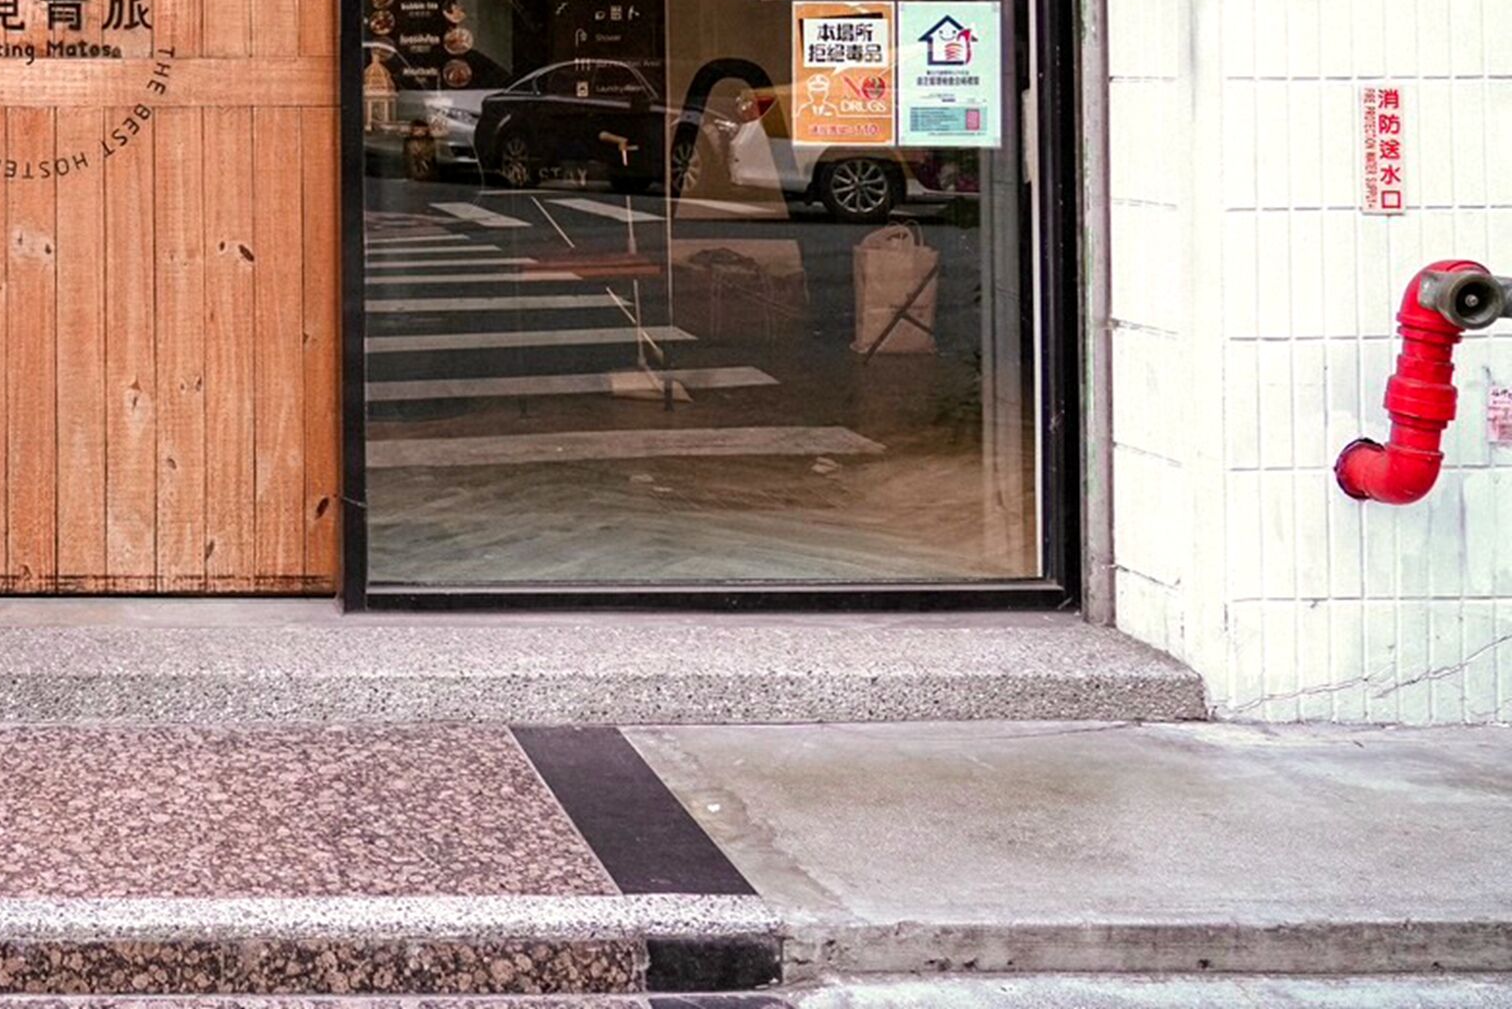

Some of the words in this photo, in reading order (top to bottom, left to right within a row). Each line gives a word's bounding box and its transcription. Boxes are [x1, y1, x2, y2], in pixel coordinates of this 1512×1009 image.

[816, 22, 874, 42] 本場所
[45, 40, 112, 59] Mates
[808, 43, 883, 63] 拒絕毒品
[146, 45, 176, 95] THE
[840, 98, 888, 113] DRUGS
[99, 102, 153, 159] BEST
[1378, 87, 1402, 209] 消防送水口
